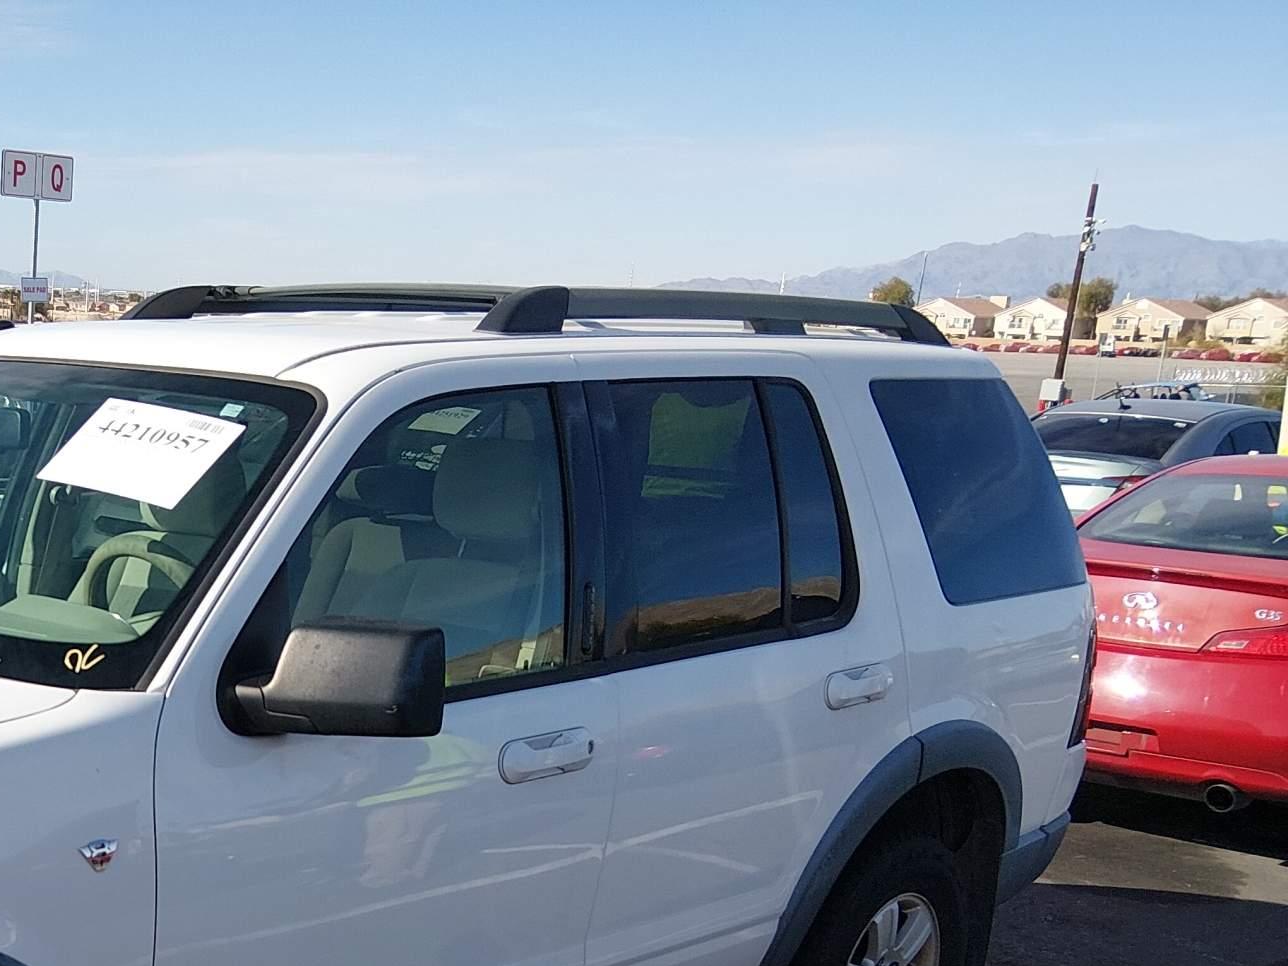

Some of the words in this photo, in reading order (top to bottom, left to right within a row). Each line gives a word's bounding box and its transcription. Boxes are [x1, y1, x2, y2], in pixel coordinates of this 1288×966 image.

[12, 159, 26, 188] P
[51, 163, 64, 193] Q
[98, 419, 211, 453] 44210957
[1254, 608, 1284, 622] G35
